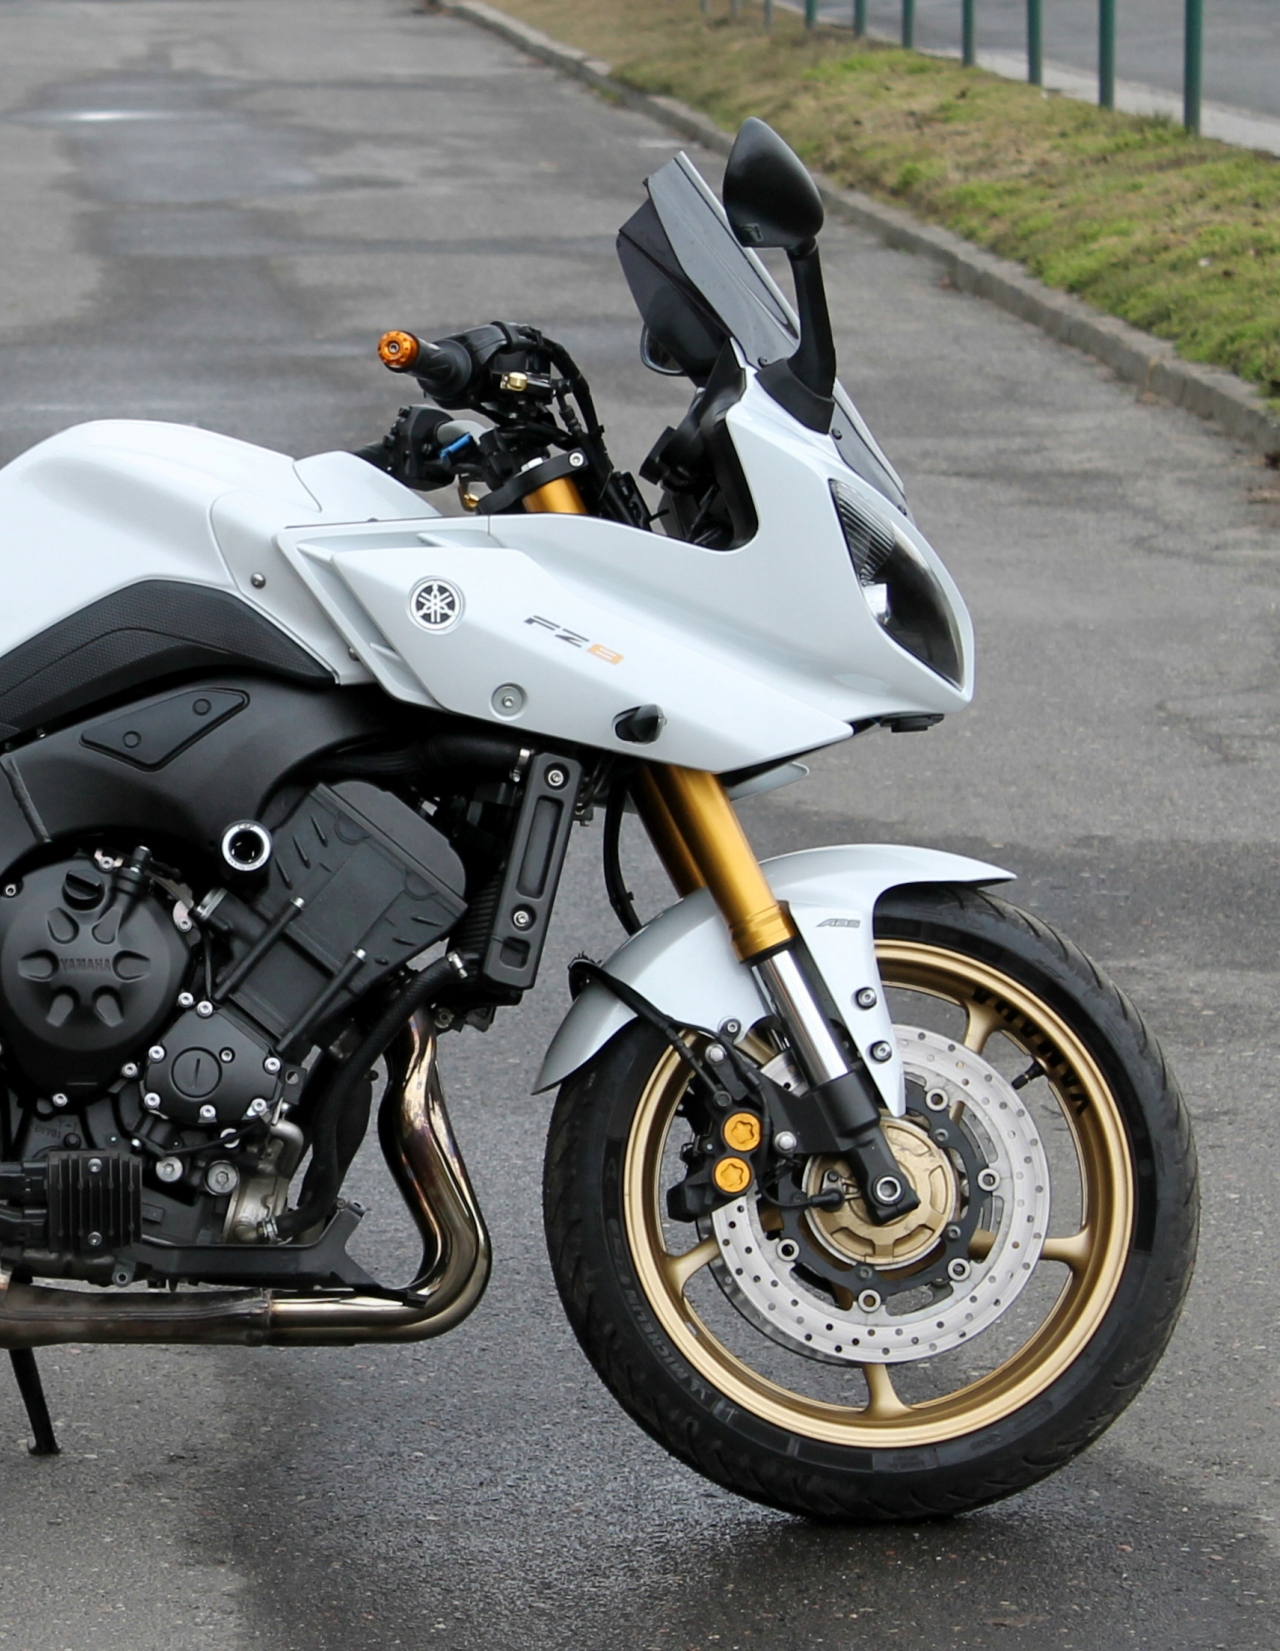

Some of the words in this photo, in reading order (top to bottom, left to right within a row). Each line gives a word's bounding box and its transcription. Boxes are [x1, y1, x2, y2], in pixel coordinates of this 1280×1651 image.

[523, 614, 624, 665] FZ8
[816, 918, 861, 928] ABS
[60, 957, 112, 972] YAMAHA
[624, 1289, 689, 1380] MICHELIN
